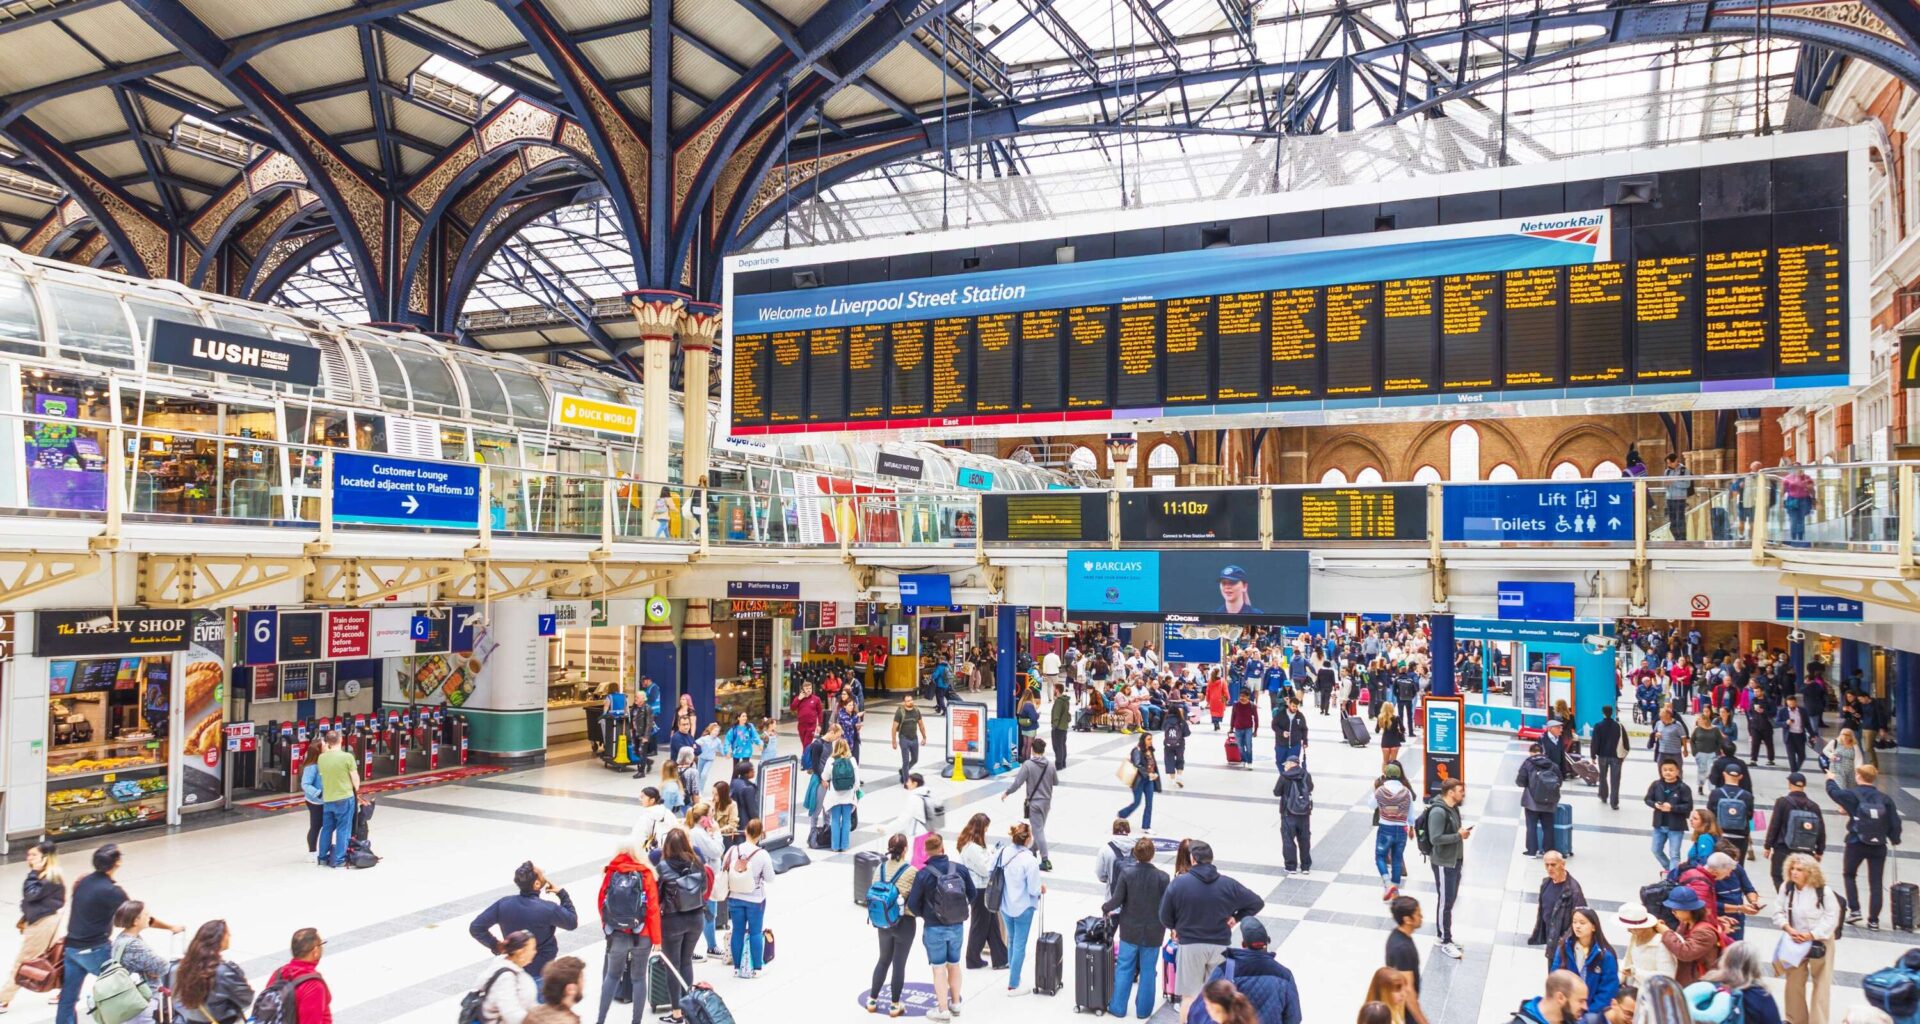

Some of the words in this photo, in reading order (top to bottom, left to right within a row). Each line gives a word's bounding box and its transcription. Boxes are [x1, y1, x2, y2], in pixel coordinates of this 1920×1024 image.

[1731, 251, 1760, 260] Platform
[738, 256, 780, 268] Departures
[1661, 258, 1689, 266] Platform
[1706, 262, 1736, 270] Stansted
[1738, 260, 1762, 268] Airport
[758, 306, 812, 321] Welcome
[815, 305, 828, 317] to
[830, 293, 904, 317] Liverpool
[906, 289, 958, 308] Street
[962, 283, 1026, 304] Station
[1706, 297, 1736, 305] Stansted
[1739, 294, 1763, 303] Airport
[1707, 331, 1737, 339] Stansted
[1739, 329, 1763, 338] Airport
[192, 338, 259, 366] LUSH
[262, 350, 290, 362] FRESH
[1457, 394, 1483, 402] West
[579, 408, 602, 420] DUCK
[603, 412, 632, 425] WORLD
[942, 418, 959, 426] East
[373, 464, 416, 477] Customer
[418, 468, 448, 482] Lounge
[968, 473, 984, 485] LEON
[341, 475, 375, 488] located
[377, 479, 414, 492] adjacent
[416, 483, 425, 492] to
[427, 482, 462, 495] Platform
[464, 486, 474, 495] 10
[1539, 493, 1566, 506] Lift
[1492, 518, 1546, 530] Toilets
[1096, 562, 1142, 571] BARCLAYS
[746, 600, 768, 611] CASA
[457, 613, 469, 633] 7
[1165, 614, 1199, 622] JCDecaux
[57, 624, 74, 634] The
[139, 619, 185, 632] SHOP
[416, 621, 423, 635] 6
[543, 618, 550, 631] 7
[254, 620, 271, 643] 6
